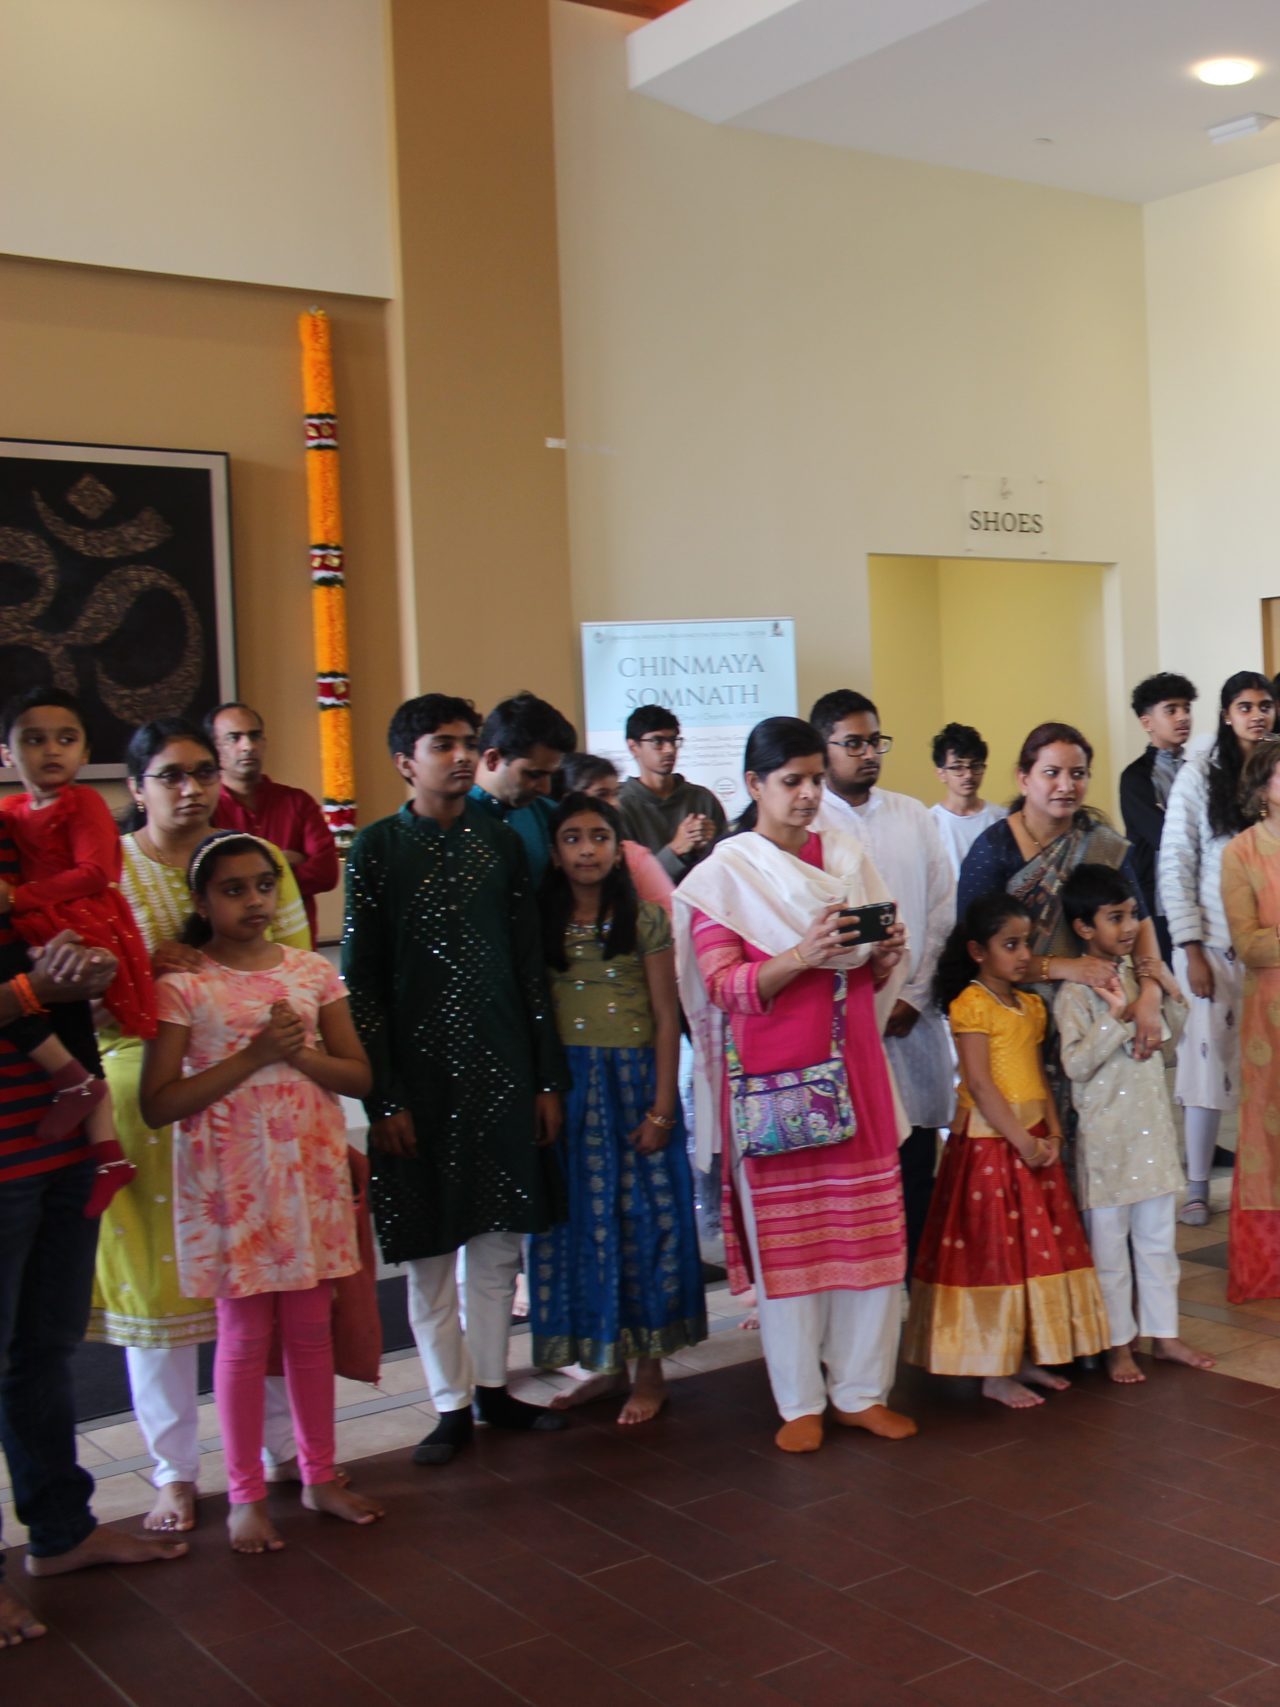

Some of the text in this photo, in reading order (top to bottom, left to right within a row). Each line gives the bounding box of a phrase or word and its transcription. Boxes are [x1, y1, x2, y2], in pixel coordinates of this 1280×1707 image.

[969, 510, 1044, 534] SHOES
[618, 653, 766, 678] CHINMAYA
[625, 684, 759, 708] SOMNATH
